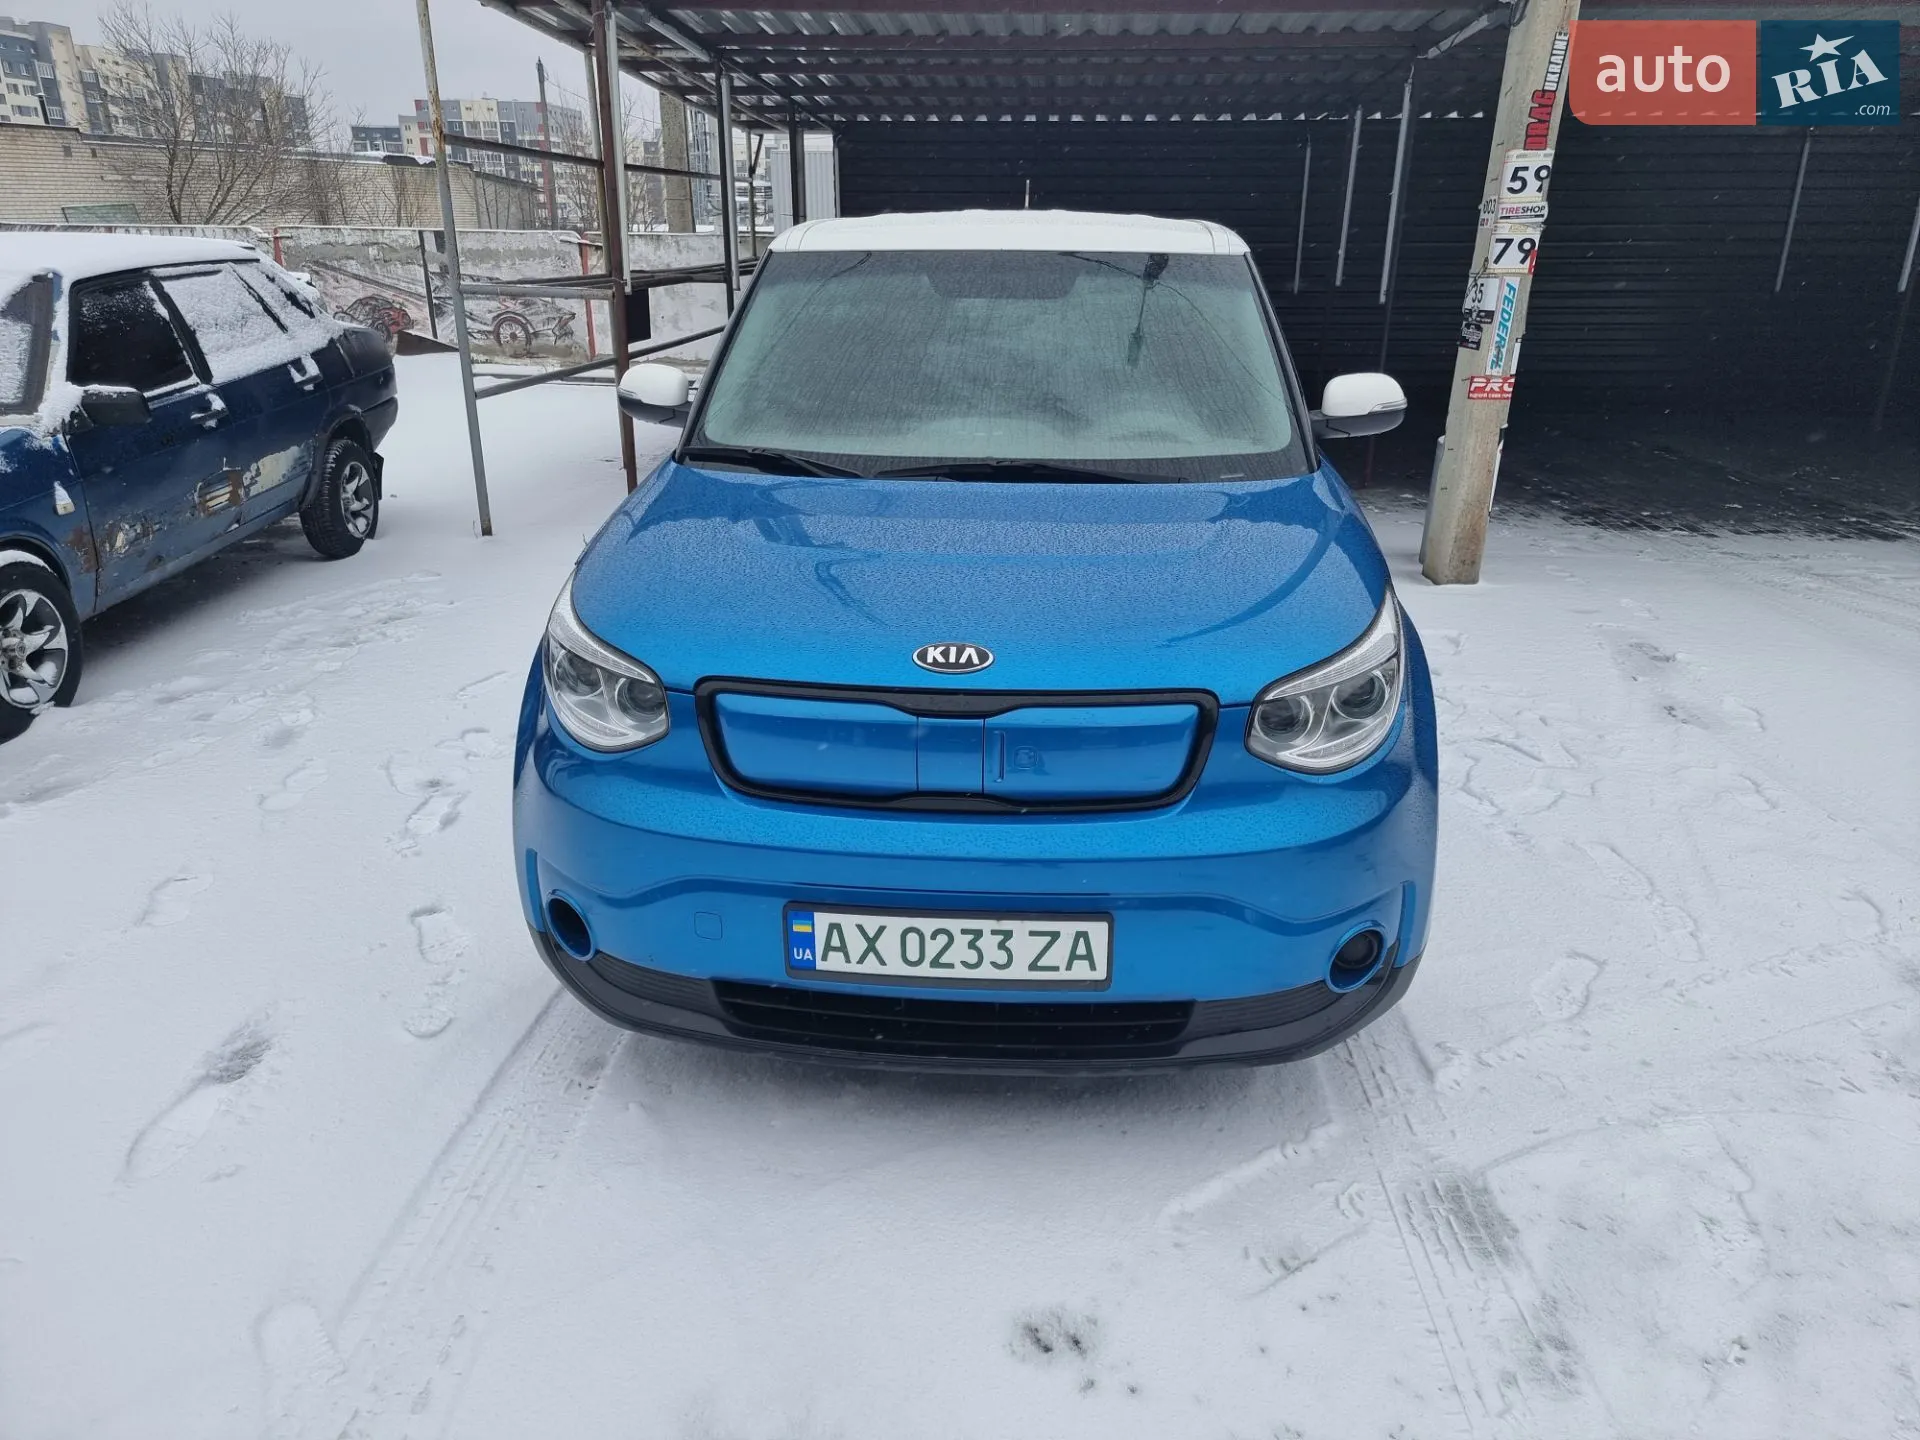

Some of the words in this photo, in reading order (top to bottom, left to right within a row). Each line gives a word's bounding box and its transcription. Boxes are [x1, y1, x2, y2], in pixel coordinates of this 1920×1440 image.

[1542, 29, 1570, 92] UKRAINE
[1506, 164, 1551, 195] 59
[1500, 205, 1546, 215] TIRESHOP
[1492, 237, 1537, 265] 79
[926, 646, 980, 665] KIA
[792, 946, 814, 961] UA
[820, 921, 888, 967] AX
[899, 926, 1014, 971] 0233
[1027, 930, 1097, 973] ZA
